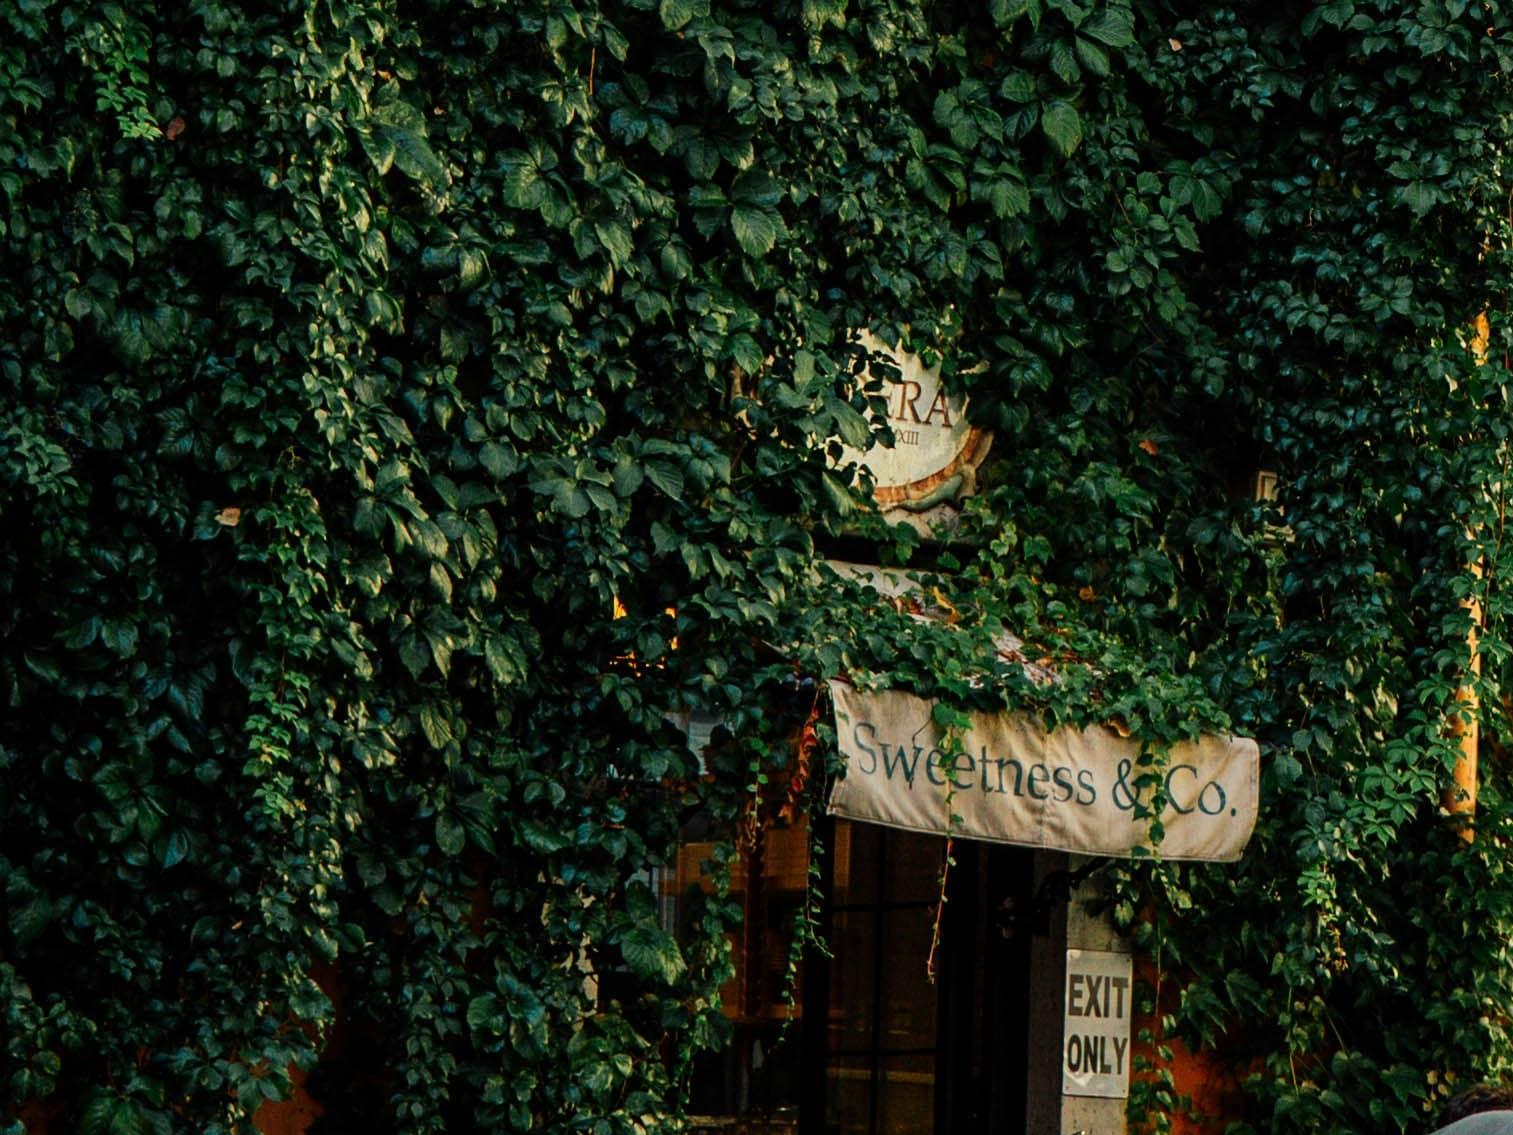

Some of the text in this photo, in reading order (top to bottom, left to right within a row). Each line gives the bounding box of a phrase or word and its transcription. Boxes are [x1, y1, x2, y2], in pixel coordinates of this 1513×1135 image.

[894, 429, 919, 446] XIII
[854, 721, 1236, 817] Sweetness & Co.
[1068, 974, 1129, 1019] EXIT
[1067, 1034, 1128, 1075] ONLY
